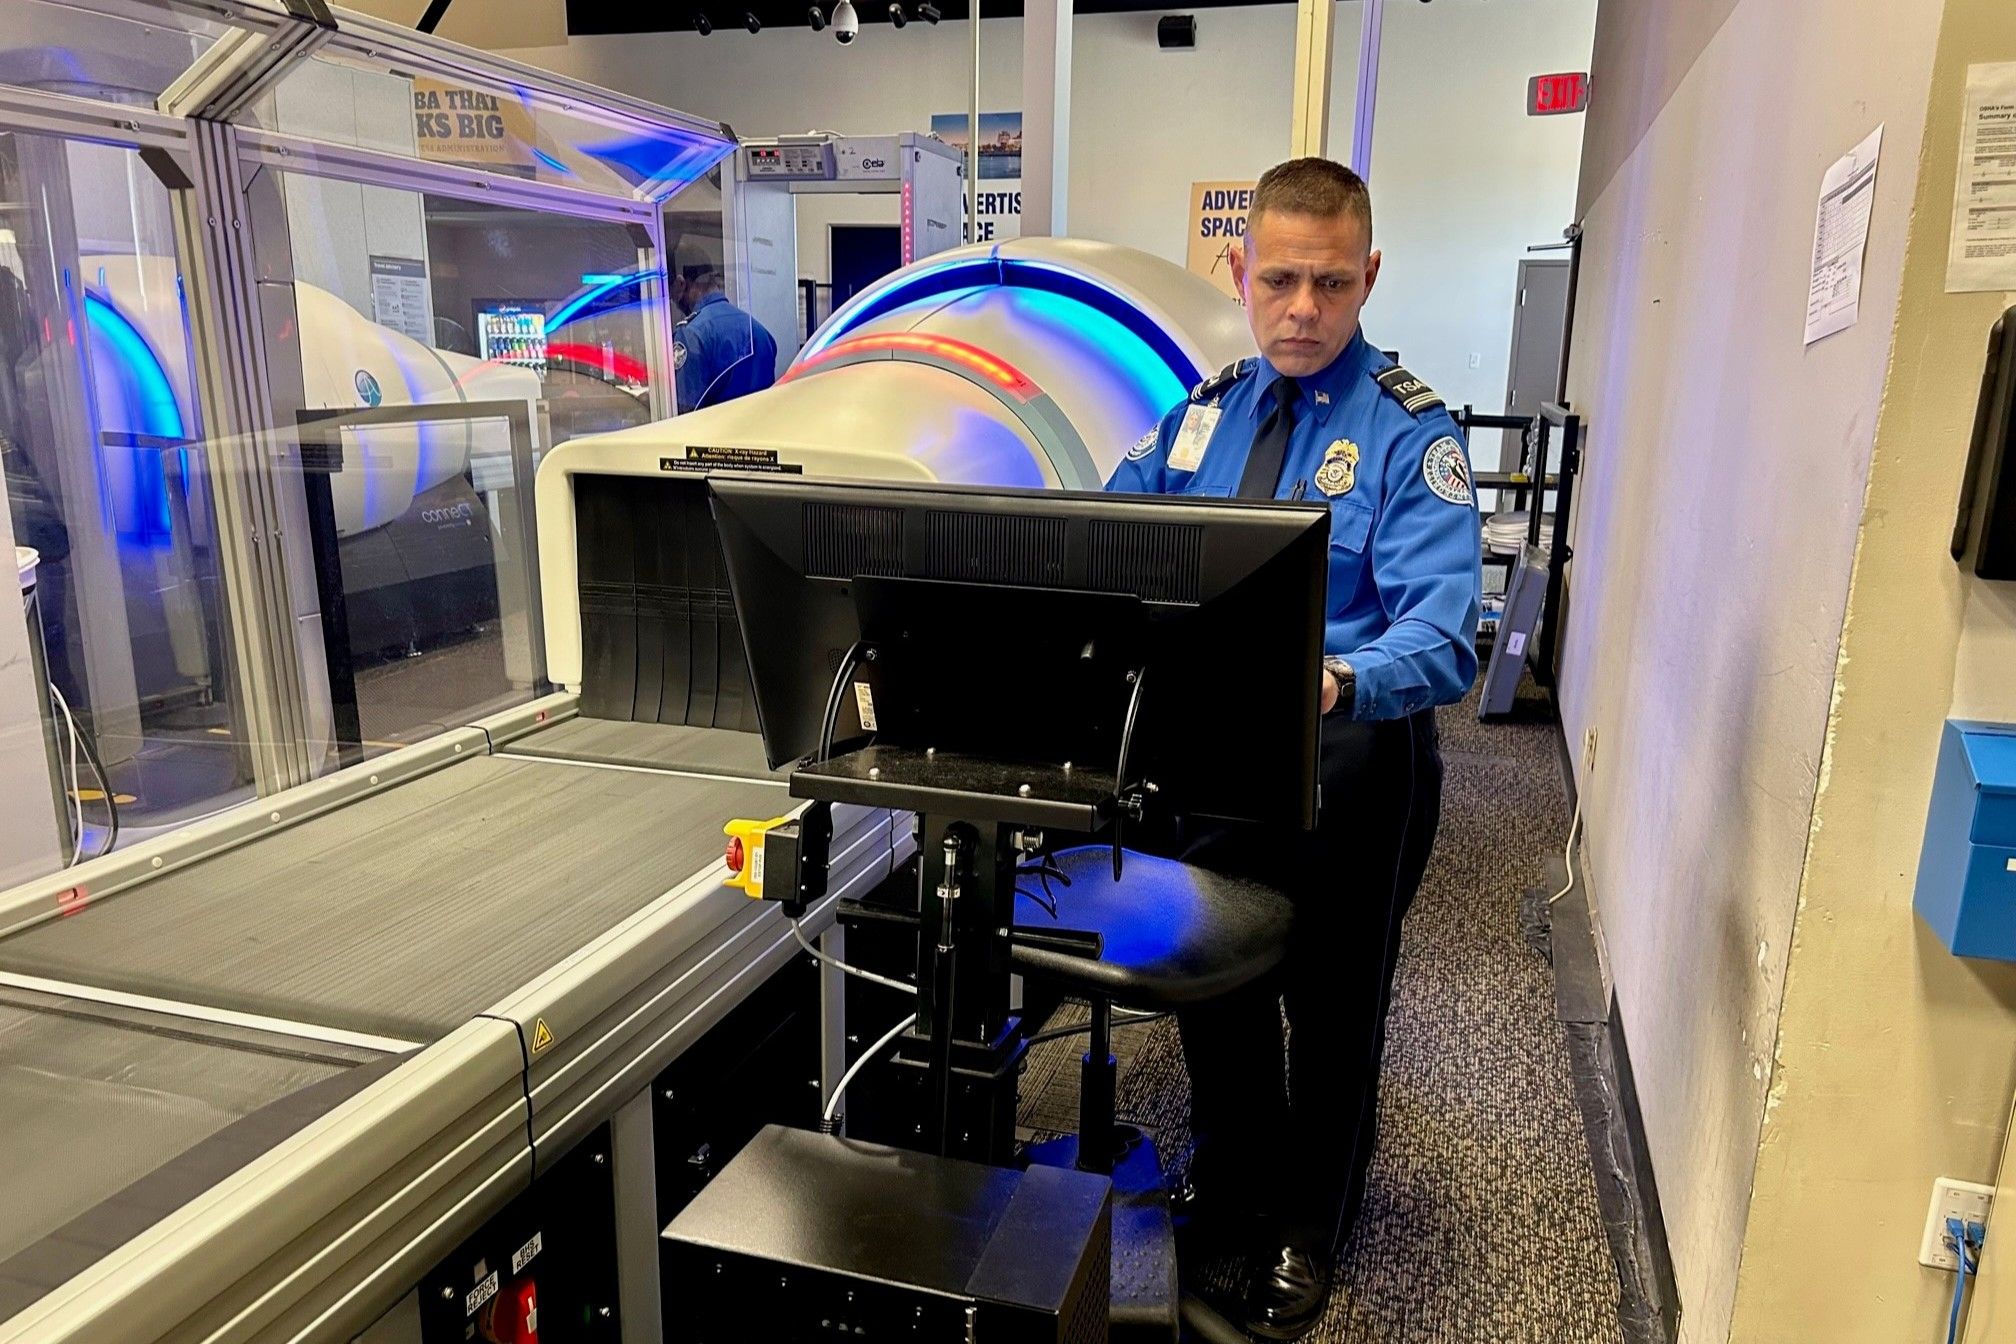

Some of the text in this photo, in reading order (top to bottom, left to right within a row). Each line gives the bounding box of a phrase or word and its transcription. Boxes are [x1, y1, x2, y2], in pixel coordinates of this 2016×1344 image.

[1537, 75, 1580, 112] EXIT
[456, 113, 505, 139] BIG
[1393, 380, 1426, 394] TSA
[516, 1244, 540, 1270] RESET
[520, 1239, 535, 1258] BHS
[467, 1282, 498, 1314] REJECT
[468, 1274, 496, 1303] FORCE
